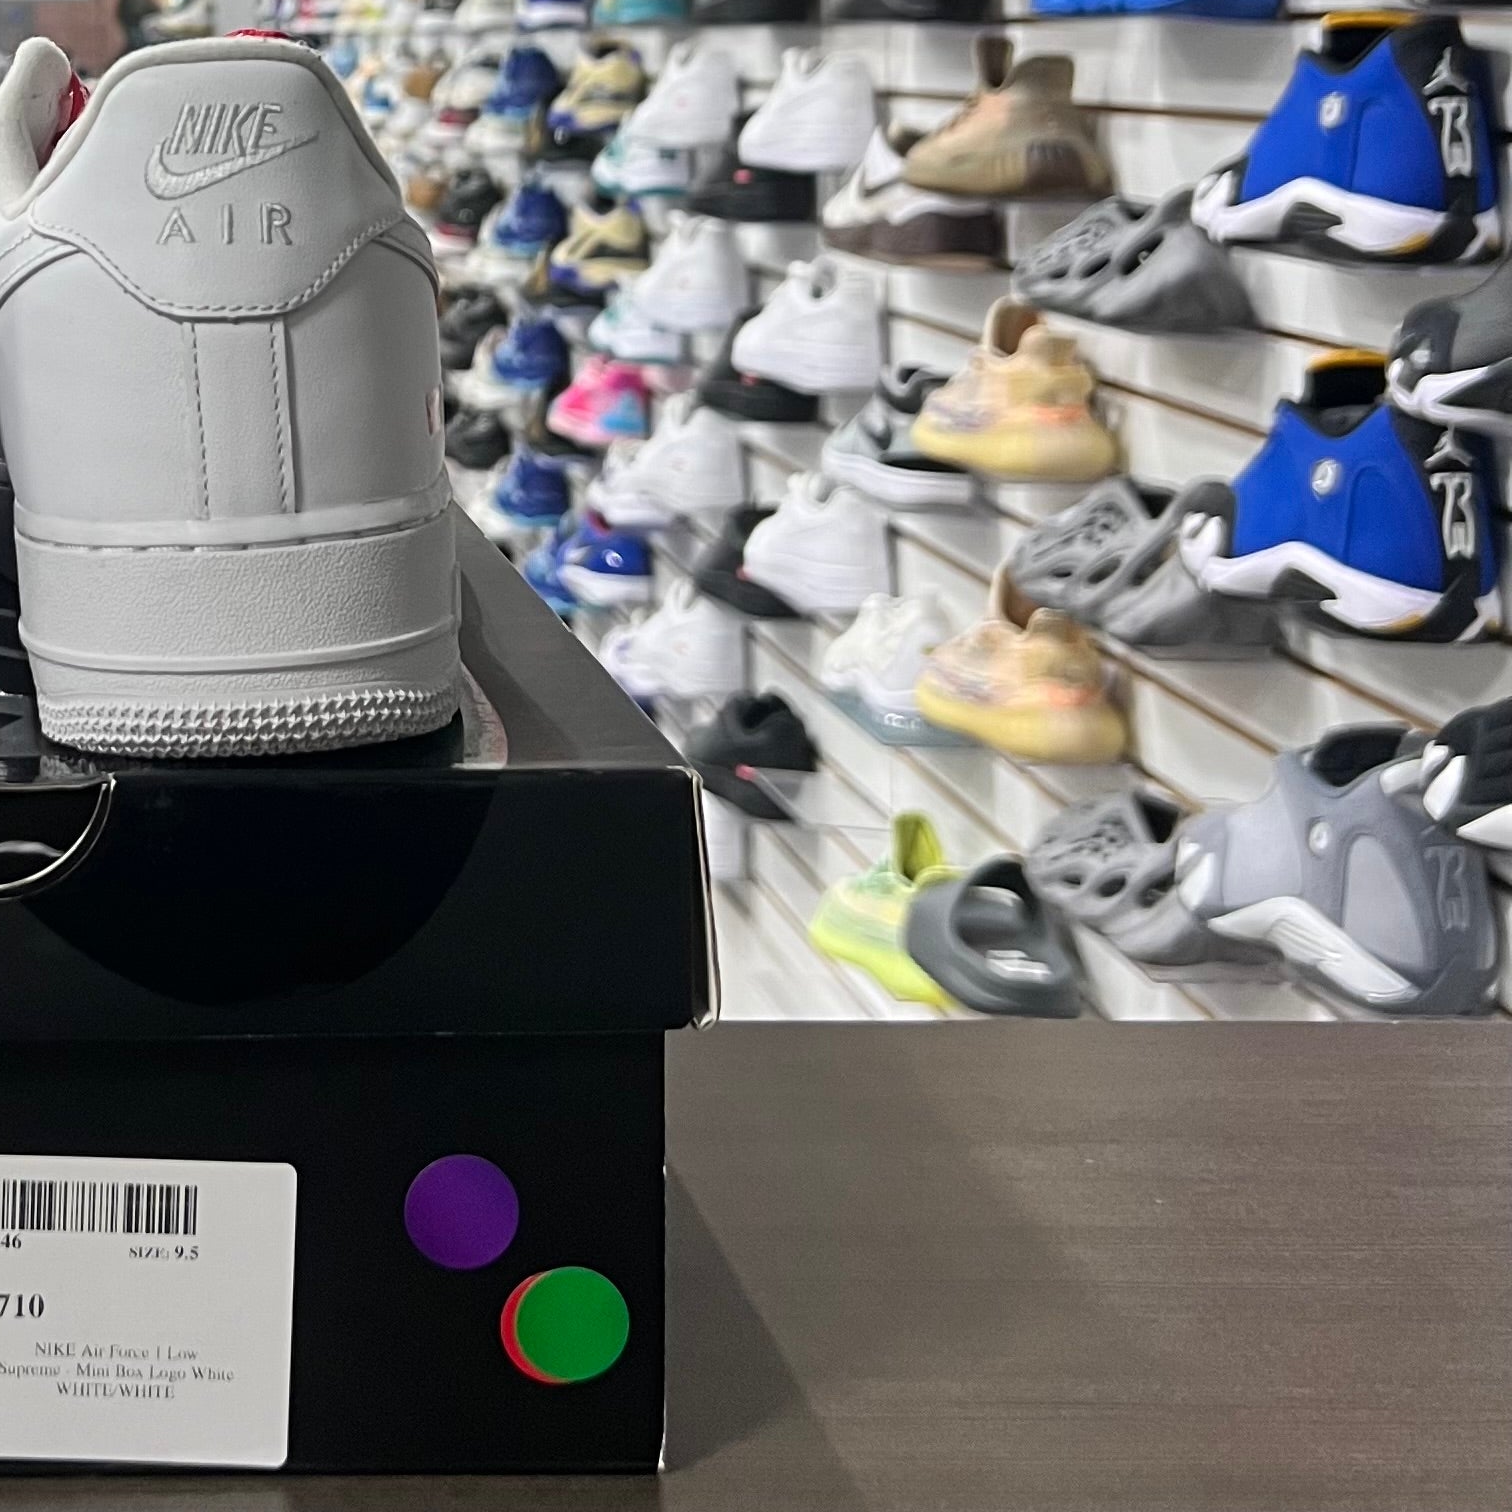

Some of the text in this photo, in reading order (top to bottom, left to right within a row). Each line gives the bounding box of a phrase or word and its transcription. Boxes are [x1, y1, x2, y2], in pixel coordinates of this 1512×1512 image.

[167, 103, 283, 157] NIKE
[156, 202, 292, 246] AIR
[174, 1245, 199, 1260] 9.5
[35, 1342, 76, 1357] NIKE
[81, 1343, 104, 1357] Air
[109, 1345, 149, 1360] Force
[167, 1346, 198, 1360] Low
[76, 1363, 110, 1377] Mini
[115, 1364, 144, 1378] Box
[149, 1364, 187, 1382] Logo
[192, 1366, 236, 1381] White
[56, 1382, 175, 1399] WHITE/WHITE
